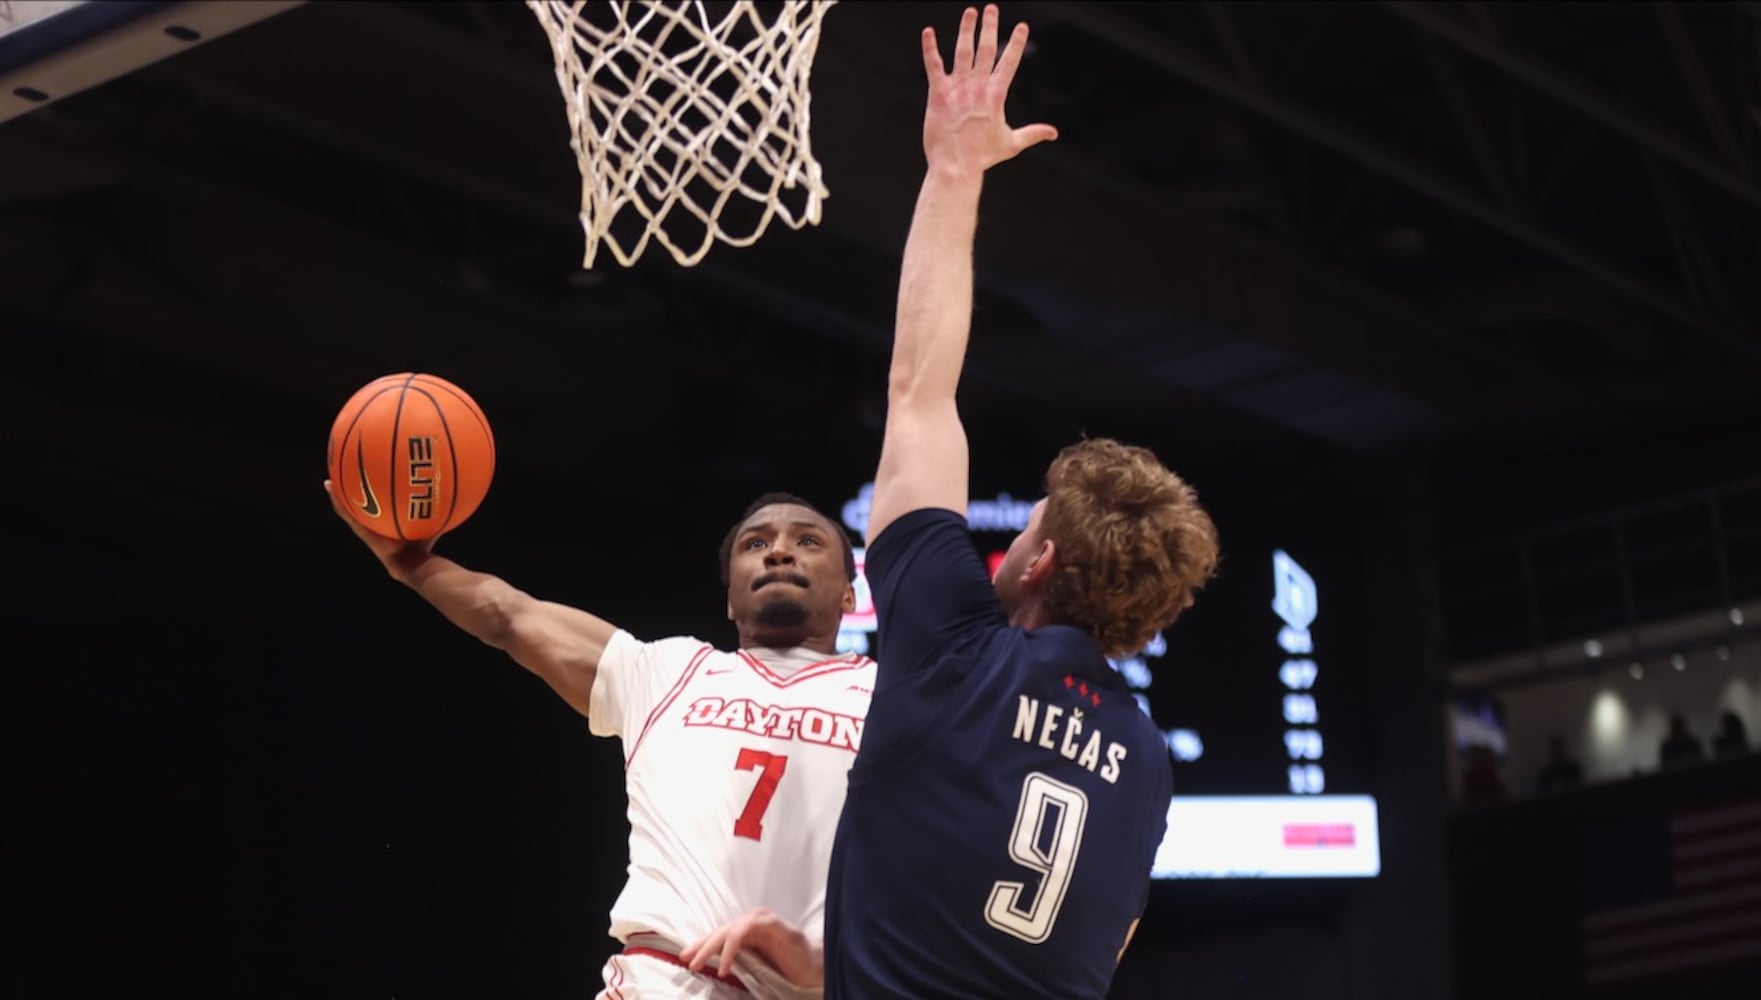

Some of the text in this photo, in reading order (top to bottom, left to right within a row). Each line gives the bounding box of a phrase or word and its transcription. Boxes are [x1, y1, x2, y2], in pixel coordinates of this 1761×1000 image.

[408, 436, 433, 521] ELITE
[683, 696, 866, 754] DAYTON
[1012, 694, 1128, 785] NEČAS
[733, 747, 788, 842] 7
[983, 771, 1089, 945] 9
